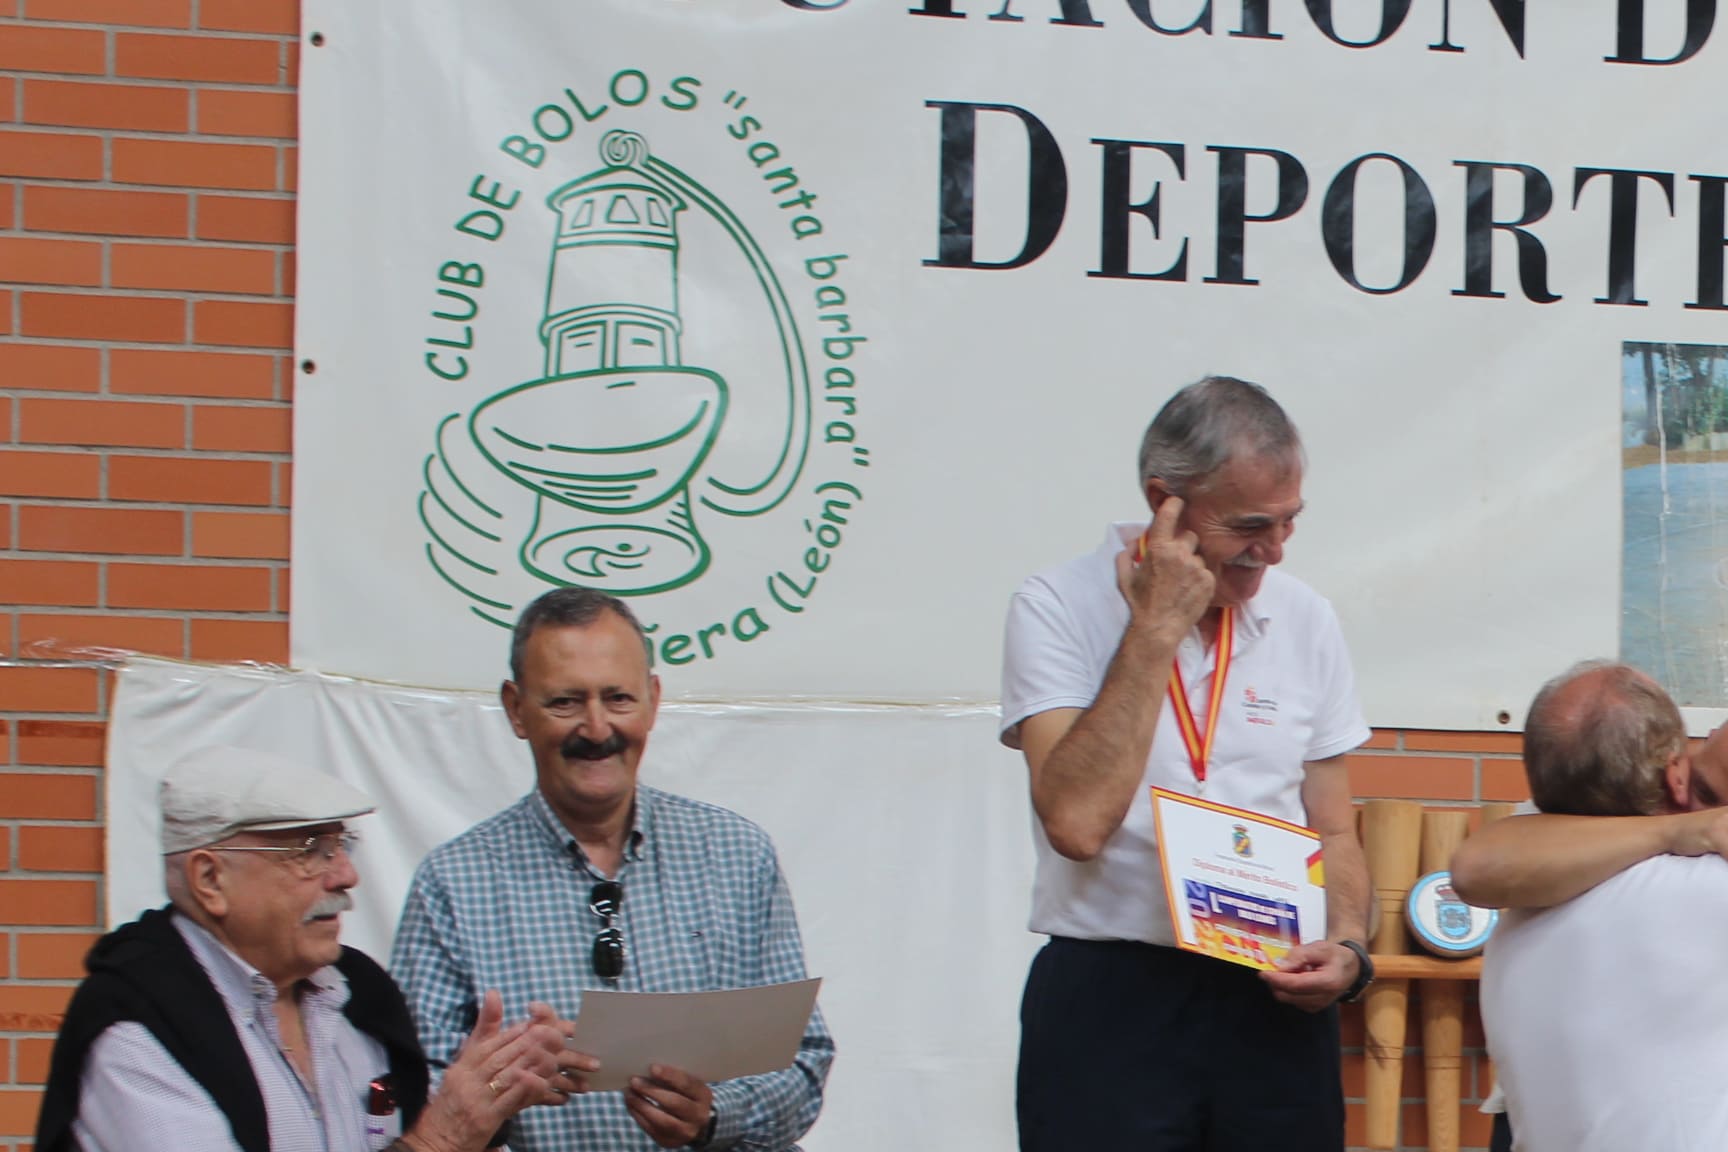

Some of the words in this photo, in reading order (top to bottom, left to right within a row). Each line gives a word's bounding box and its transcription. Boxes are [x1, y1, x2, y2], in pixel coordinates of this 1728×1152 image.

[499, 69, 703, 169] BOLOS
[722, 90, 823, 241] "santa
[454, 173, 522, 241] DE
[424, 260, 485, 381] CLUB
[803, 253, 870, 467] barbara"
[766, 480, 863, 614] (León)
